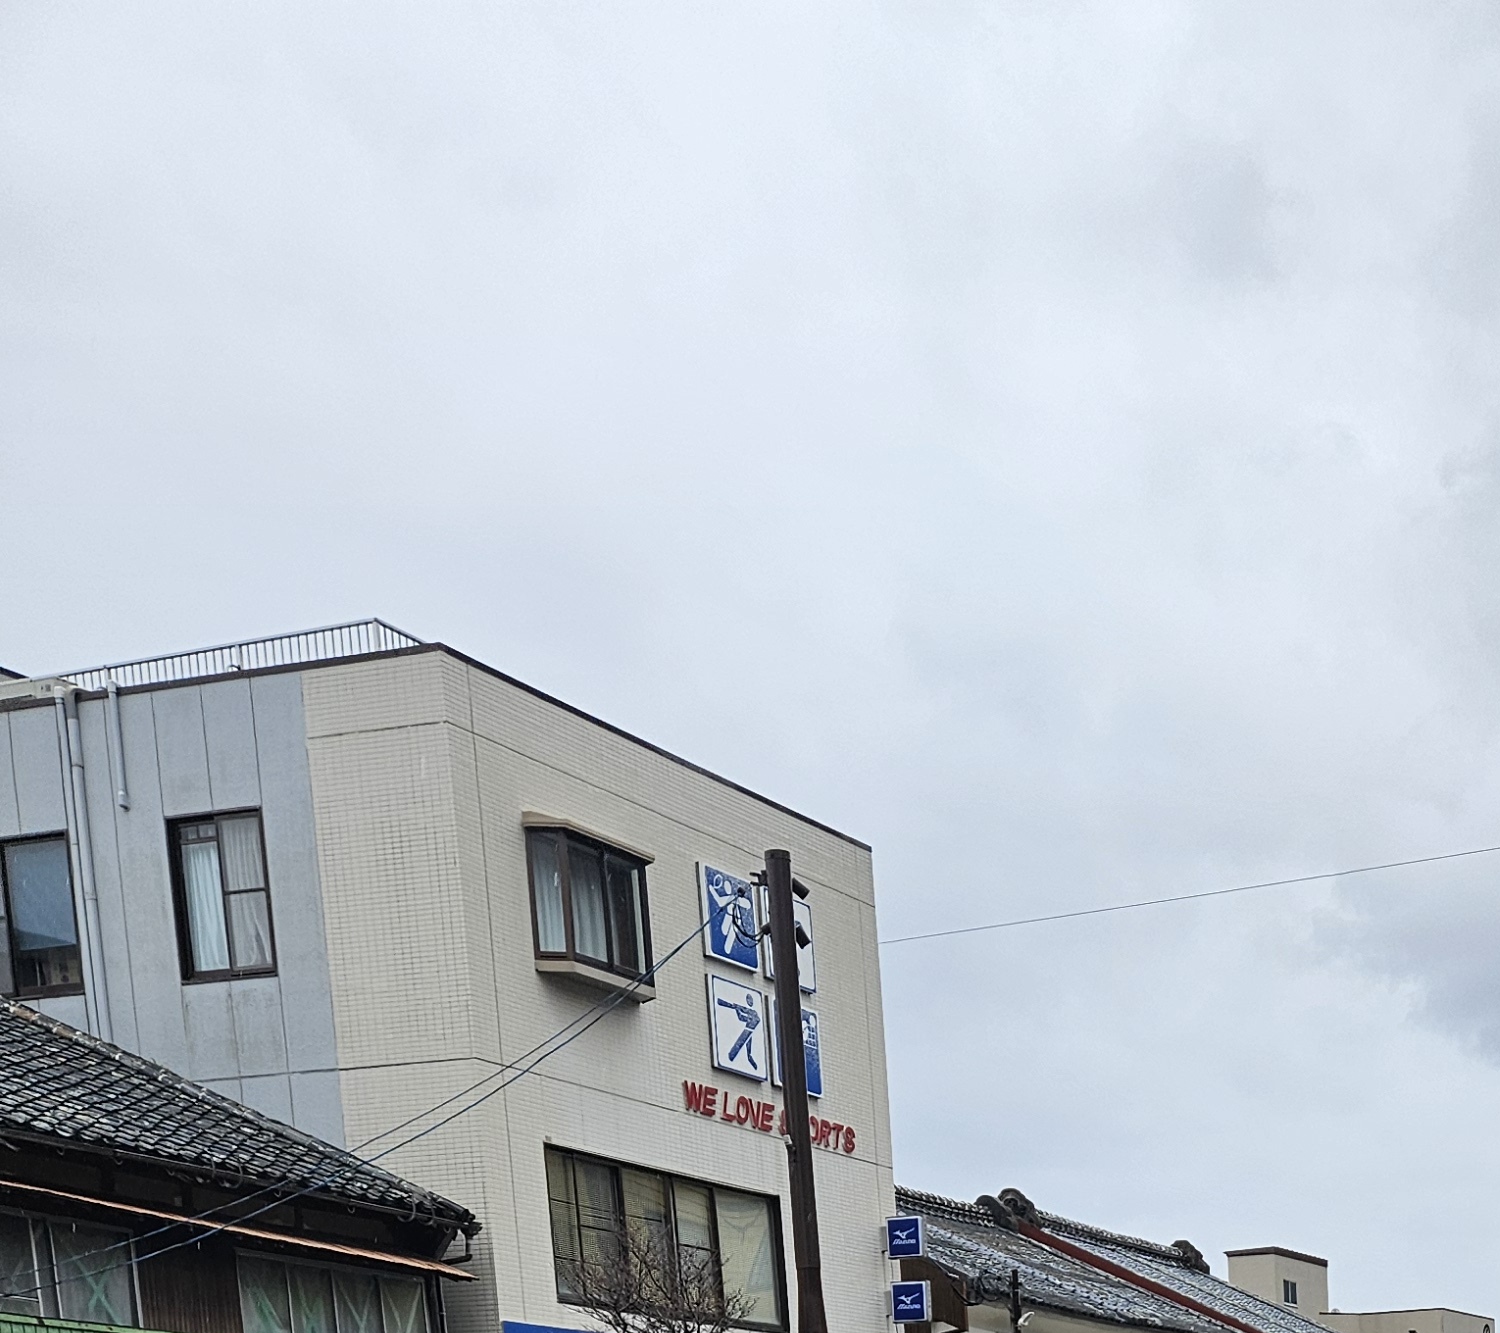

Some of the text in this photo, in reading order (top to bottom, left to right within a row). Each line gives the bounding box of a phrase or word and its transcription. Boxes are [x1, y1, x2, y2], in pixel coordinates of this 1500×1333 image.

[683, 1079, 856, 1153] WE LOVE SORTS
